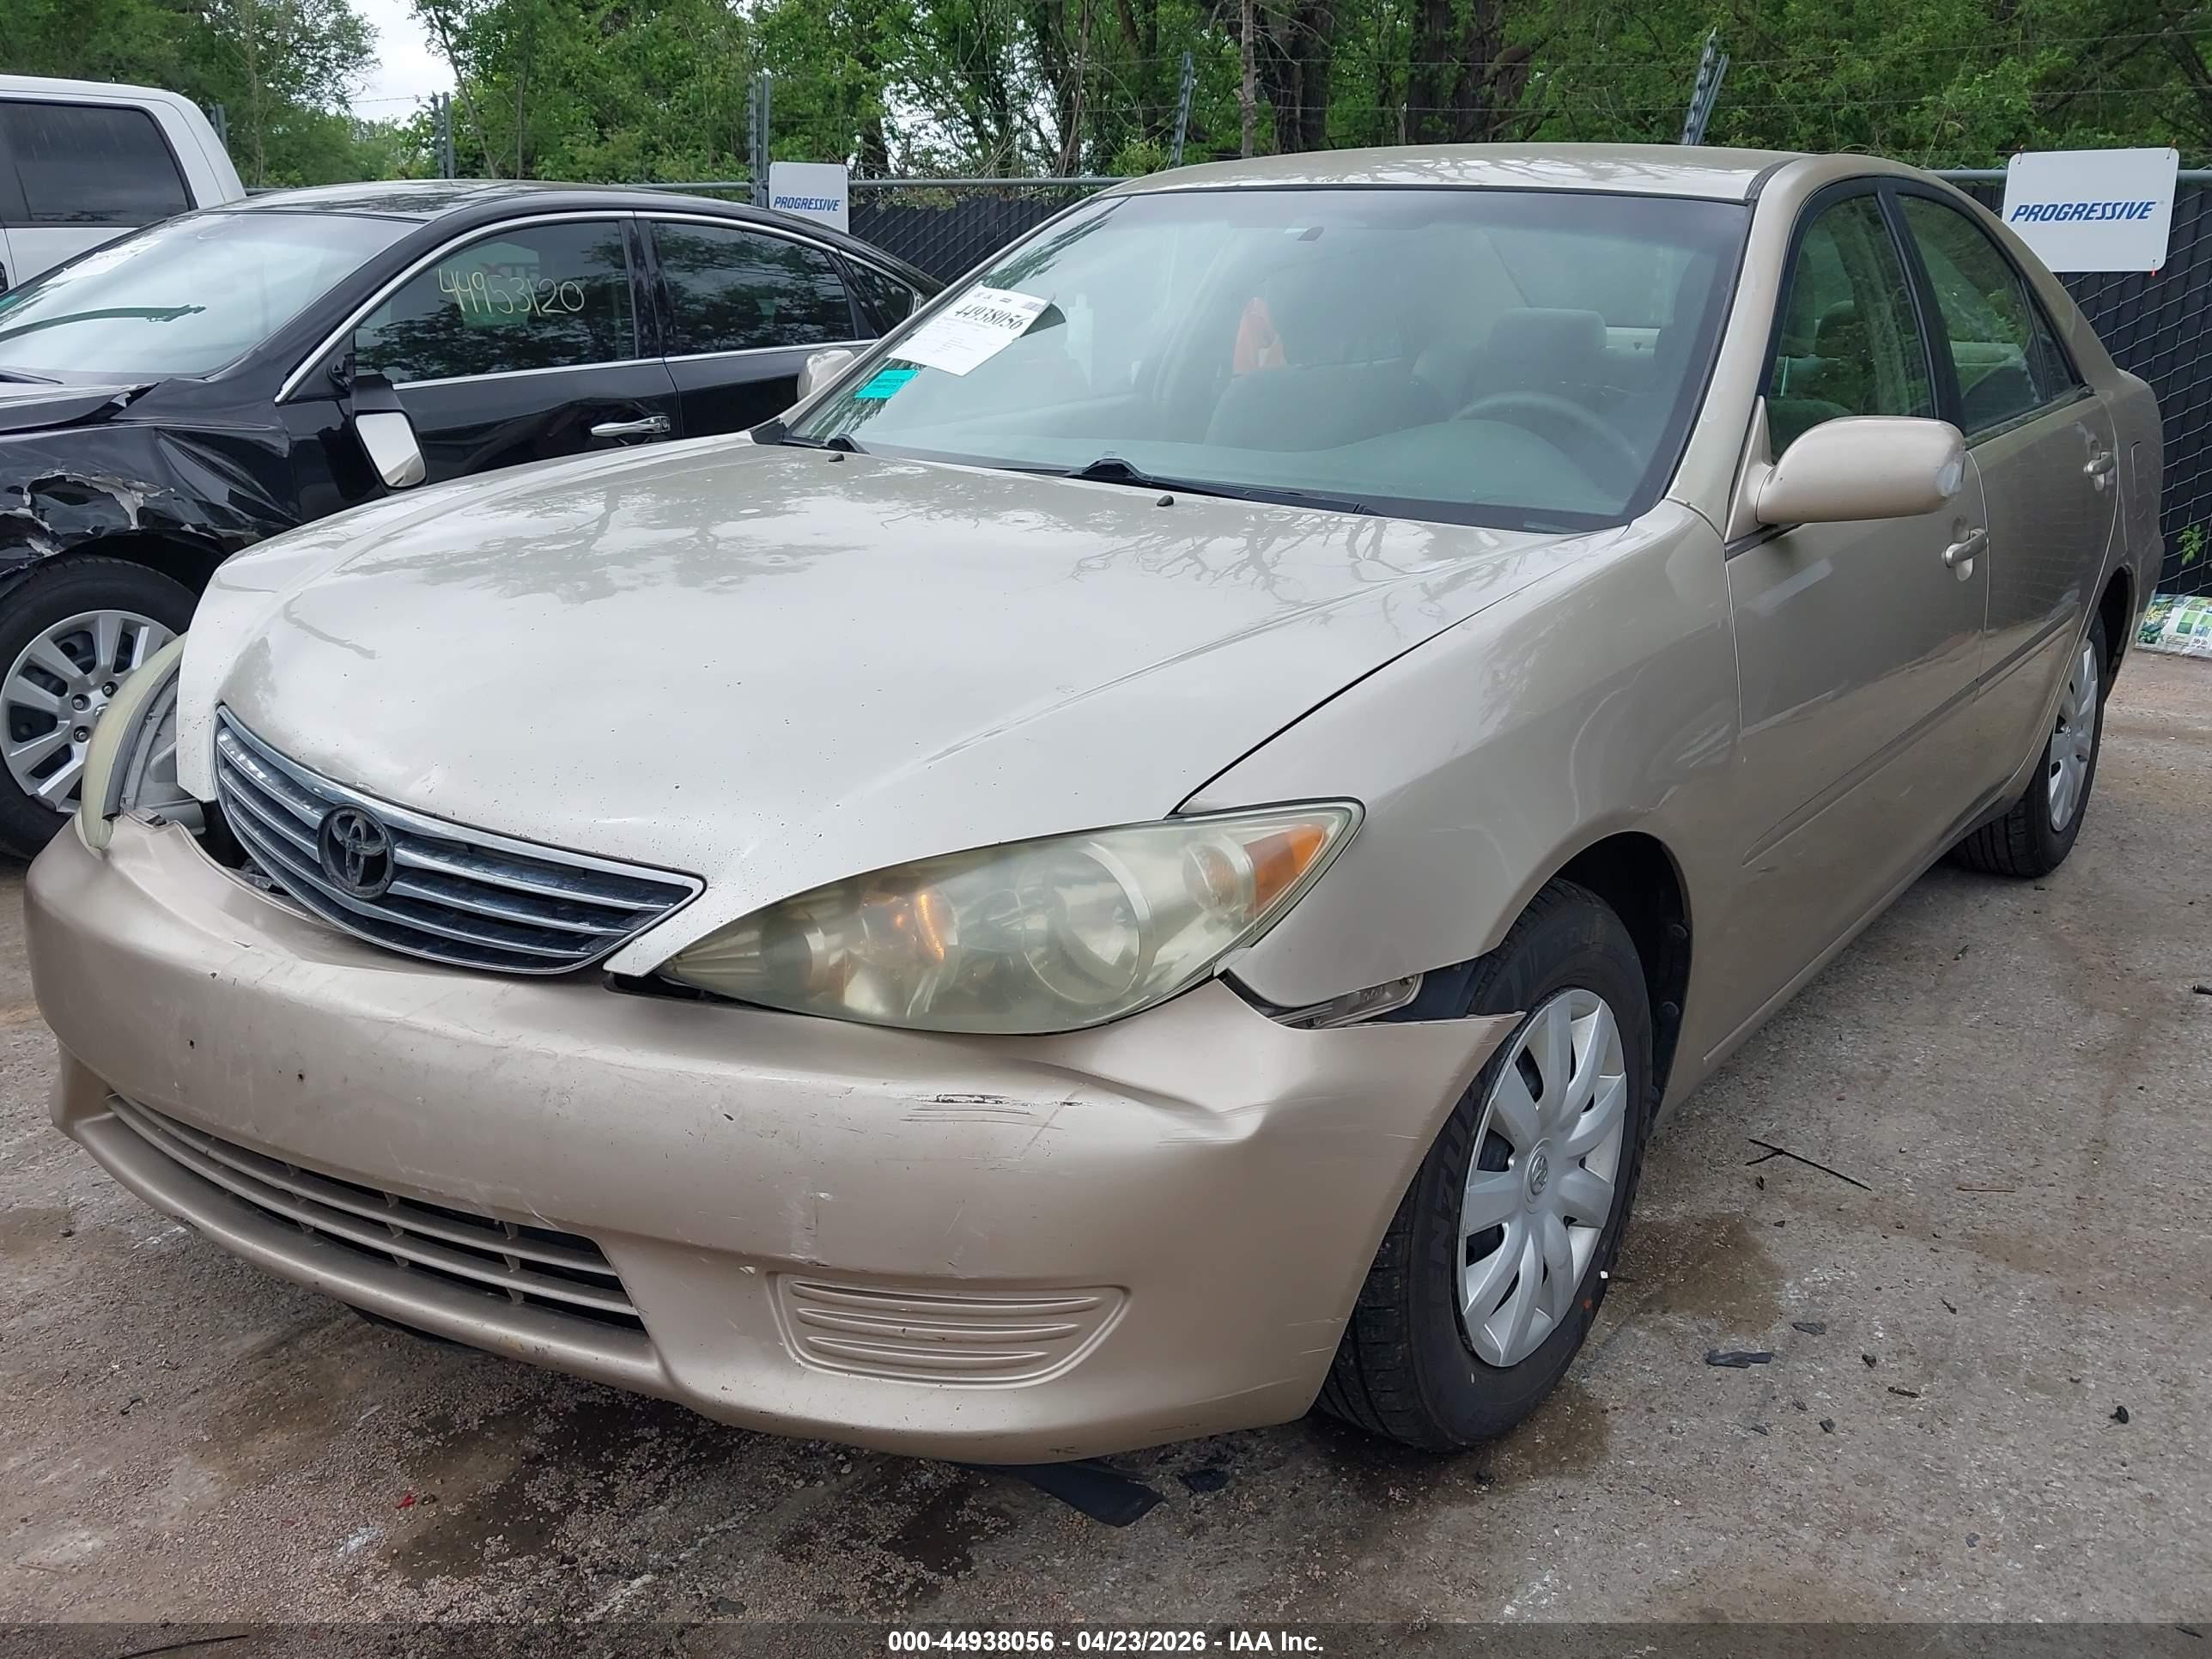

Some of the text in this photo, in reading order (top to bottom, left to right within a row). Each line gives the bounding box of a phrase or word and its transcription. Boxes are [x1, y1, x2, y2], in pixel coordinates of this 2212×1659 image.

[774, 196, 841, 212] PROGRESSIVE
[2010, 201, 2157, 222] PROGRESSIVE
[438, 267, 585, 317] 44953120
[955, 304, 1030, 330] 44938056
